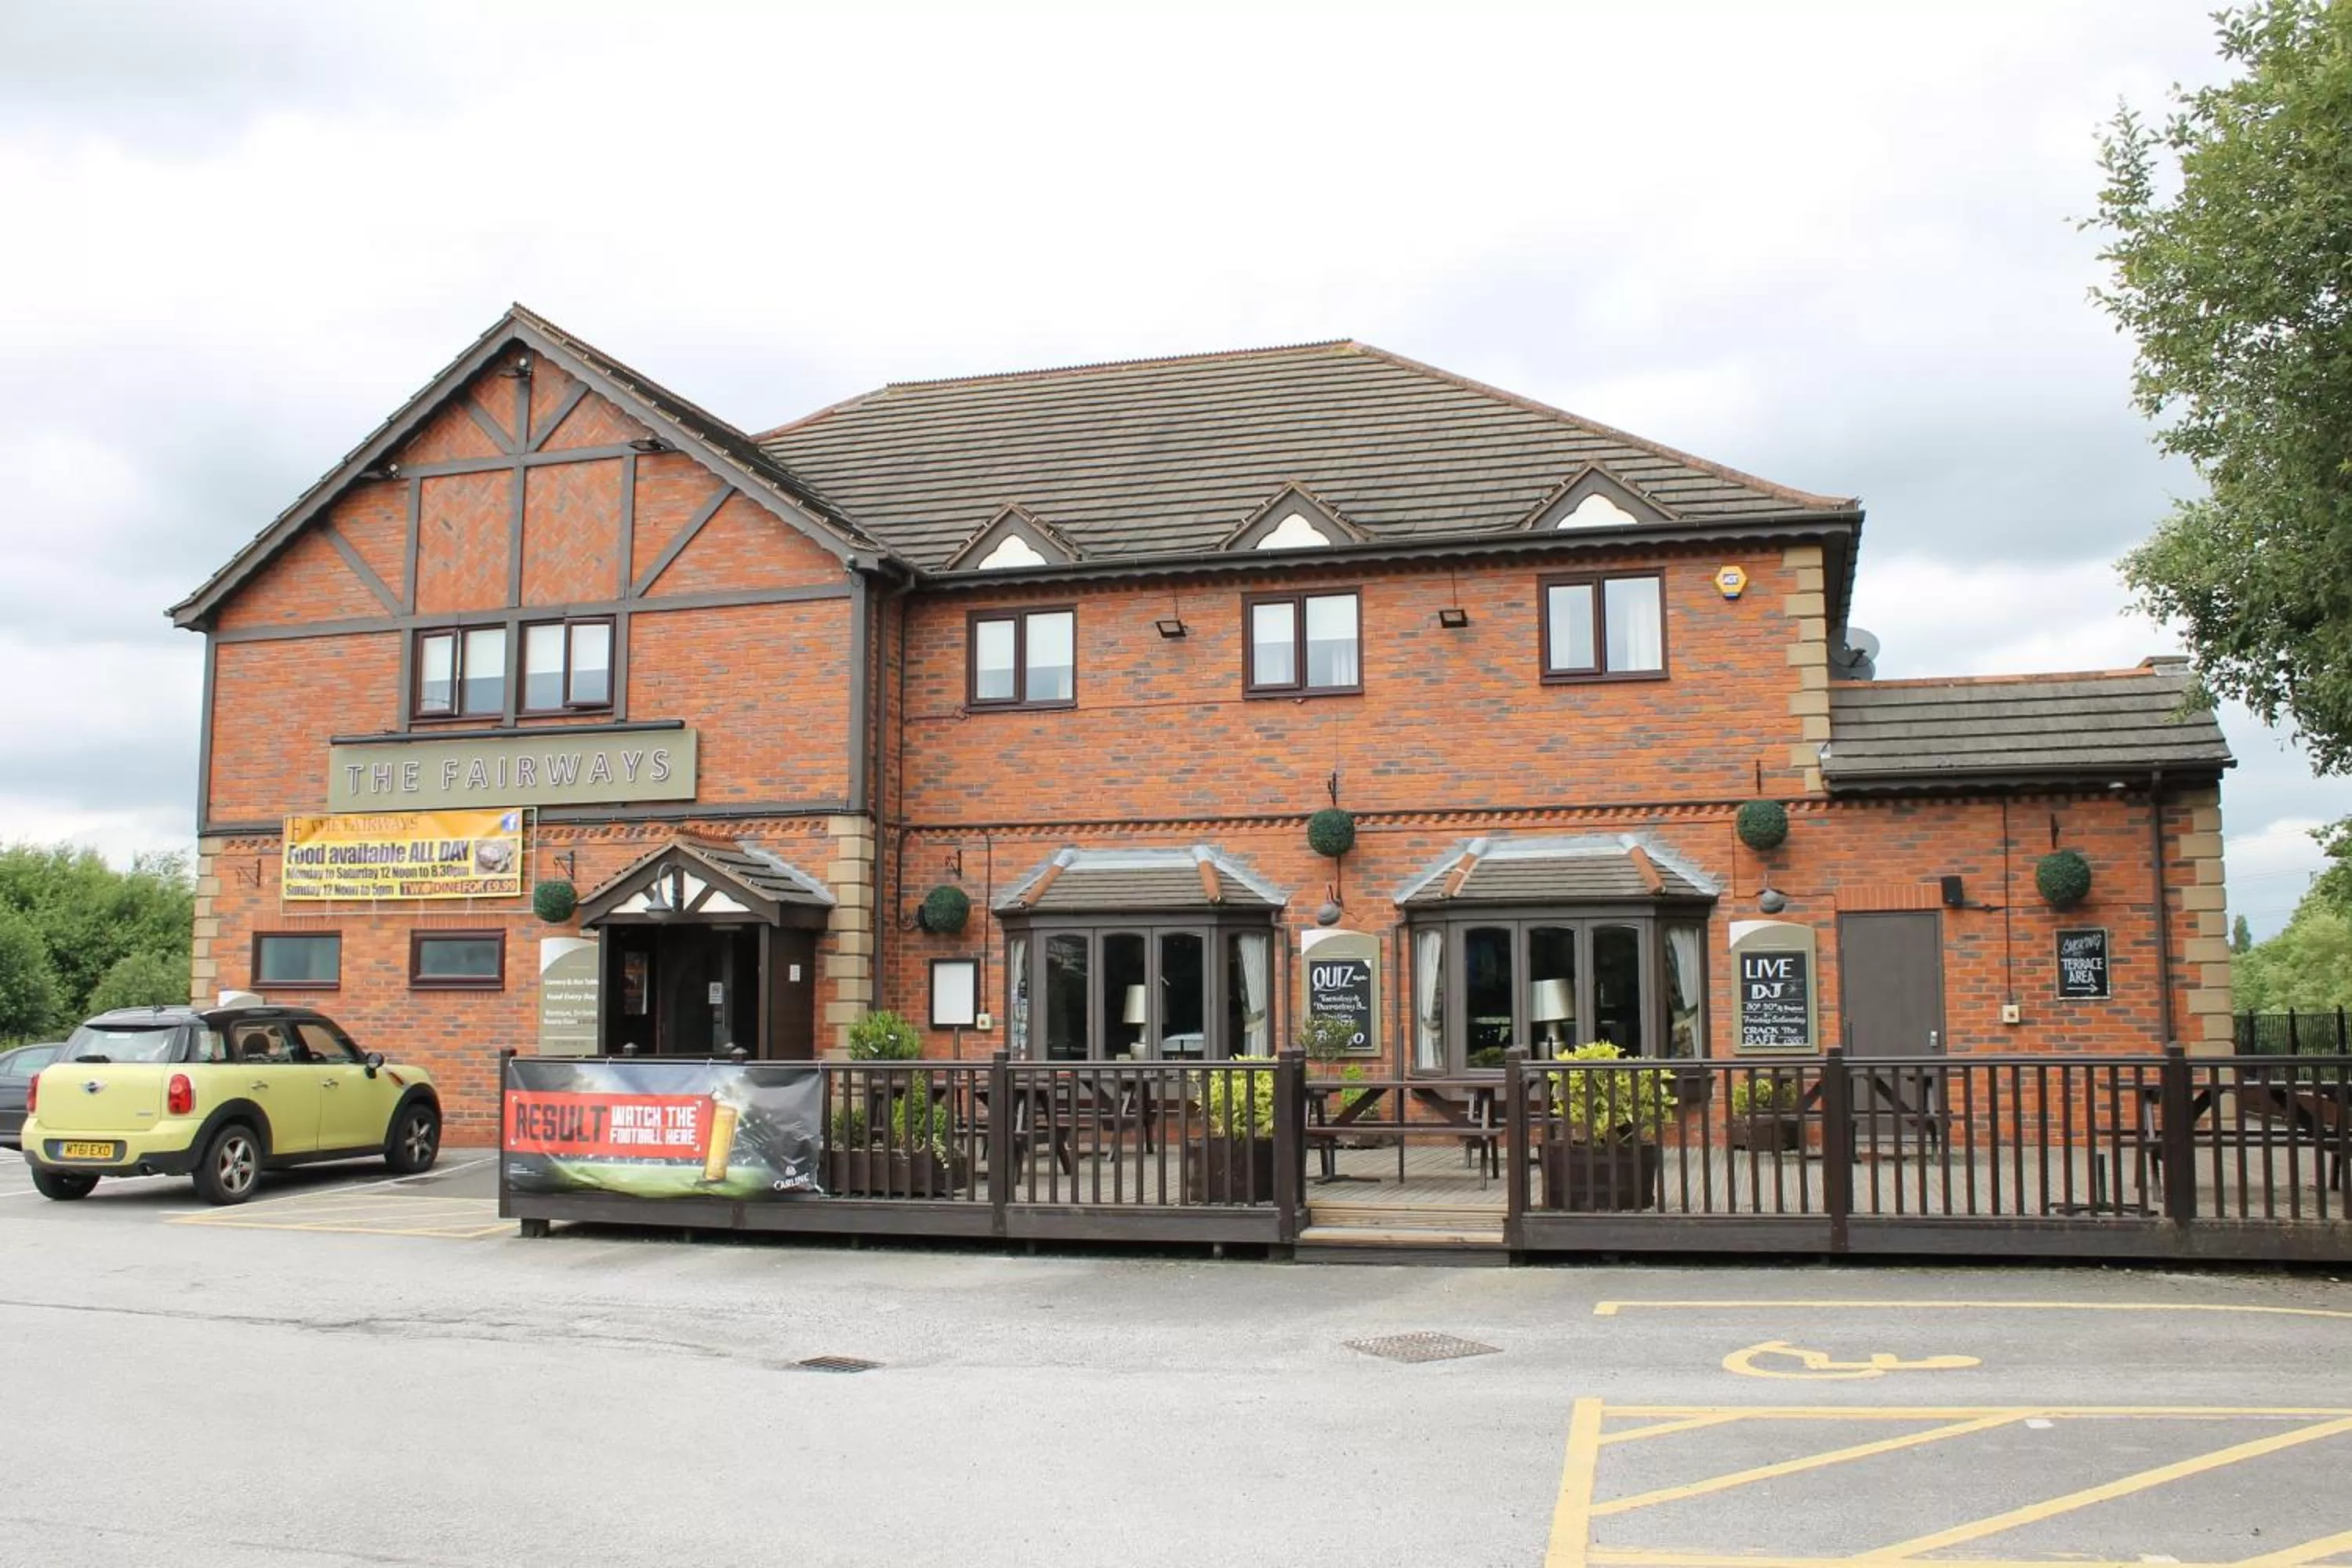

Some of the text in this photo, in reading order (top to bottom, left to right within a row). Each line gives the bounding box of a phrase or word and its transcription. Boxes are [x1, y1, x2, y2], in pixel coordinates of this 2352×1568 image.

[346, 749, 671, 795] THE FAIRWAYS
[288, 840, 470, 865] Food available ALL DAY
[325, 868, 334, 878] to
[336, 867, 378, 880] Saturday
[380, 866, 390, 878] 12
[392, 866, 417, 878] Noon
[419, 866, 429, 877] to
[286, 884, 394, 896] Sunday 12 Noon to 5pm
[486, 880, 516, 892] £9.99
[1744, 957, 1795, 979] LIVE
[2060, 957, 2103, 970] TERRACE
[1312, 966, 1356, 992] QUIZ
[2067, 970, 2096, 983] AREA
[1751, 982, 1784, 1000] DJ
[515, 1102, 608, 1143] RESULT
[611, 1105, 697, 1127] WATCH THE
[608, 1127, 696, 1145] FOOTBALL HERE
